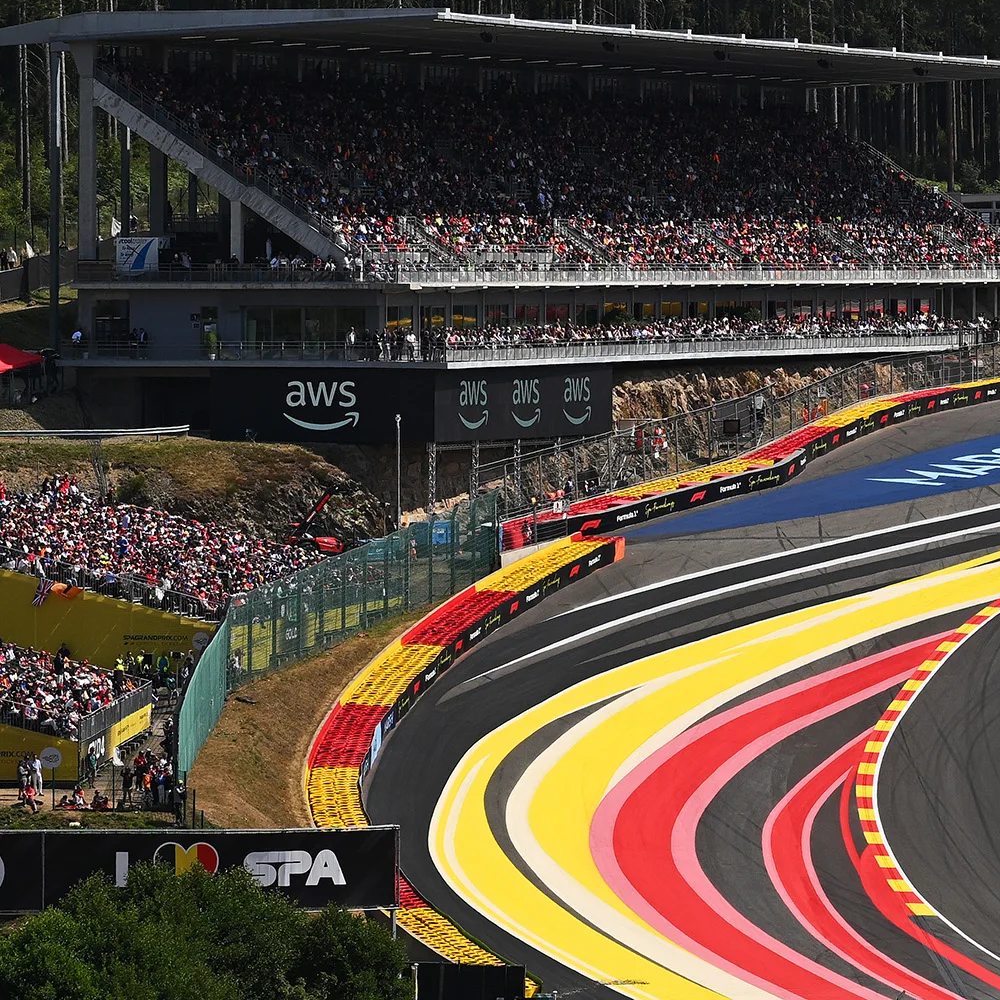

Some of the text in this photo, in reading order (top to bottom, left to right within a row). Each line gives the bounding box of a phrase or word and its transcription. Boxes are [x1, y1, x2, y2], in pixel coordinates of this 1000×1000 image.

[286, 380, 357, 407] aws
[459, 379, 488, 406] aws
[511, 378, 540, 405] aws
[564, 376, 591, 404] aws
[243, 849, 347, 887] SPA
